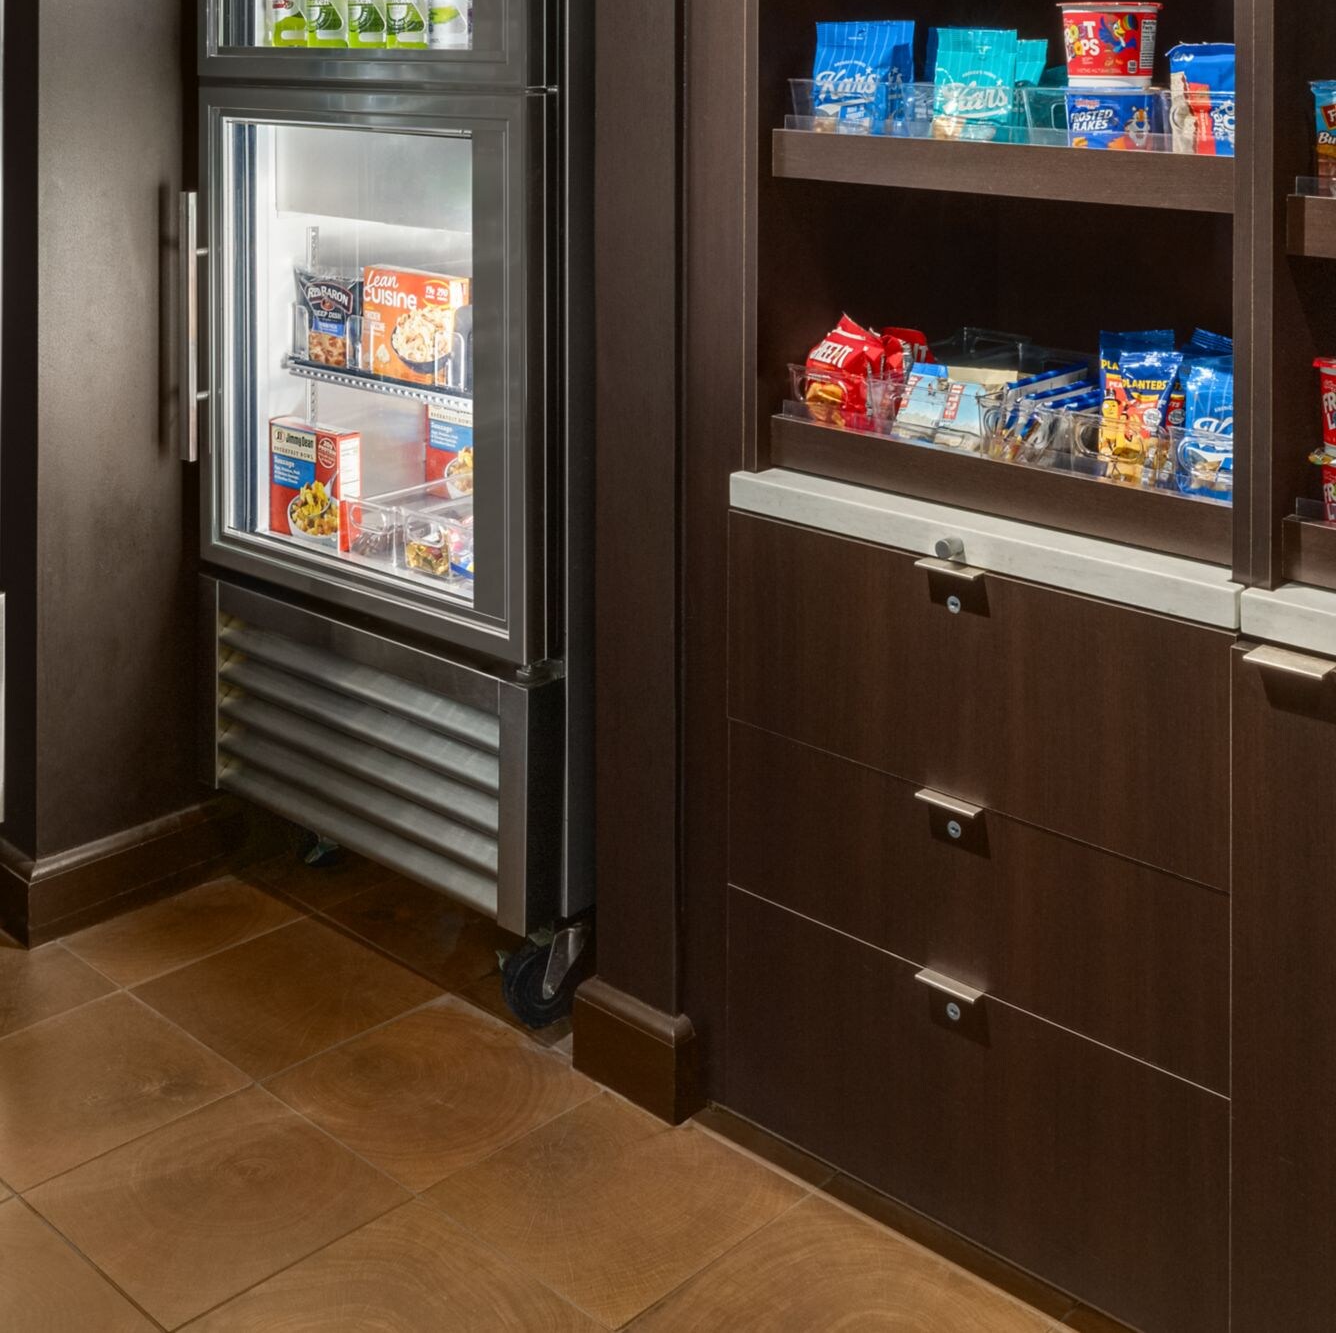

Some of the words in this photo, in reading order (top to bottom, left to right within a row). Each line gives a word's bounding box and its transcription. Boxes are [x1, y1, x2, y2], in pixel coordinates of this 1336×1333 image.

[815, 67, 877, 102] Kar's
[1071, 109, 1114, 125] FROSTED
[1072, 119, 1109, 133] FLAKES
[367, 270, 400, 290] Lean
[321, 285, 349, 307] BARON
[1121, 378, 1167, 391] PLANTERS
